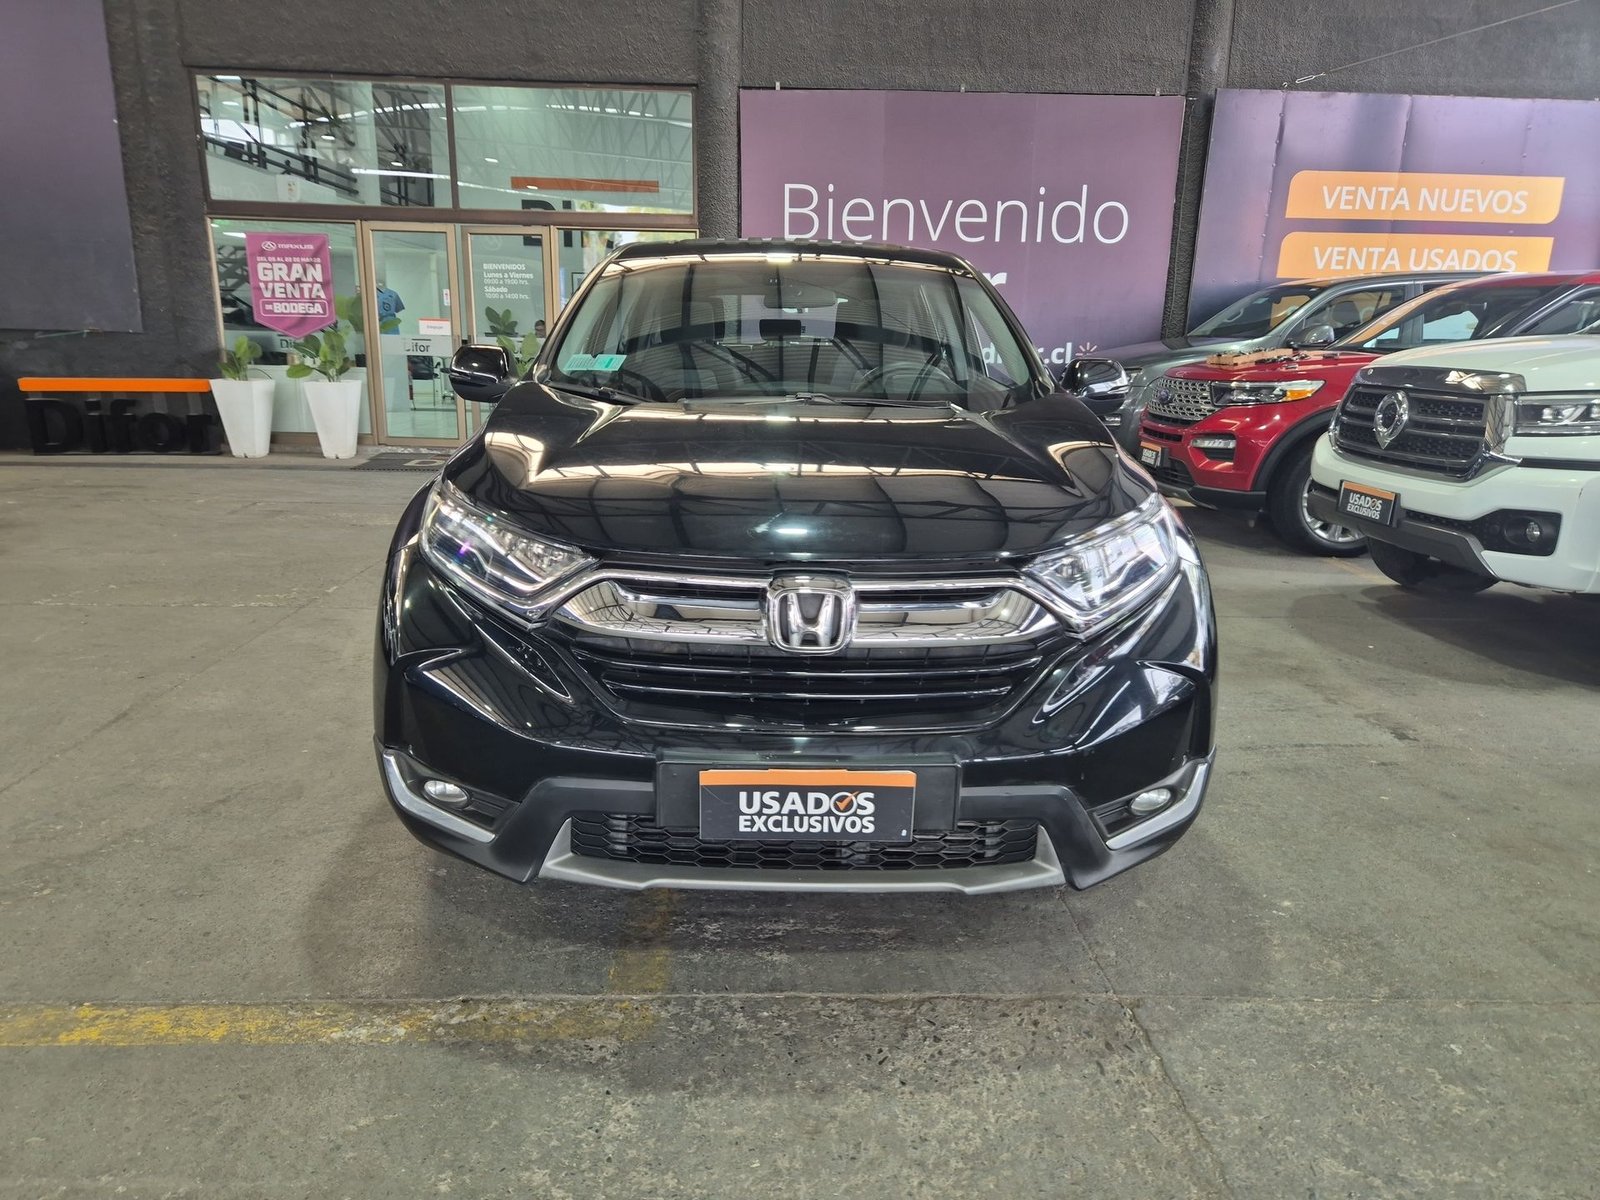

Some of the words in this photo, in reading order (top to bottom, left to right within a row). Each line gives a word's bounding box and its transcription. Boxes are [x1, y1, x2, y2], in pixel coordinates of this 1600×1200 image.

[1322, 185, 1410, 211] VENTA
[1418, 187, 1529, 215] NUEVOS
[783, 183, 1129, 244] Bienvenido
[1313, 246, 1401, 270] VENTA
[1408, 248, 1518, 272] USADOS
[257, 262, 323, 282] GRAN
[259, 282, 326, 299] VENTA
[273, 302, 324, 314] BODEGA
[24, 397, 214, 455] Difor
[1347, 503, 1380, 520] EXCLUSIVOS
[1349, 492, 1382, 511] USADOS
[738, 791, 875, 816] USADOS
[738, 815, 875, 833] EXCLUSIVOS
